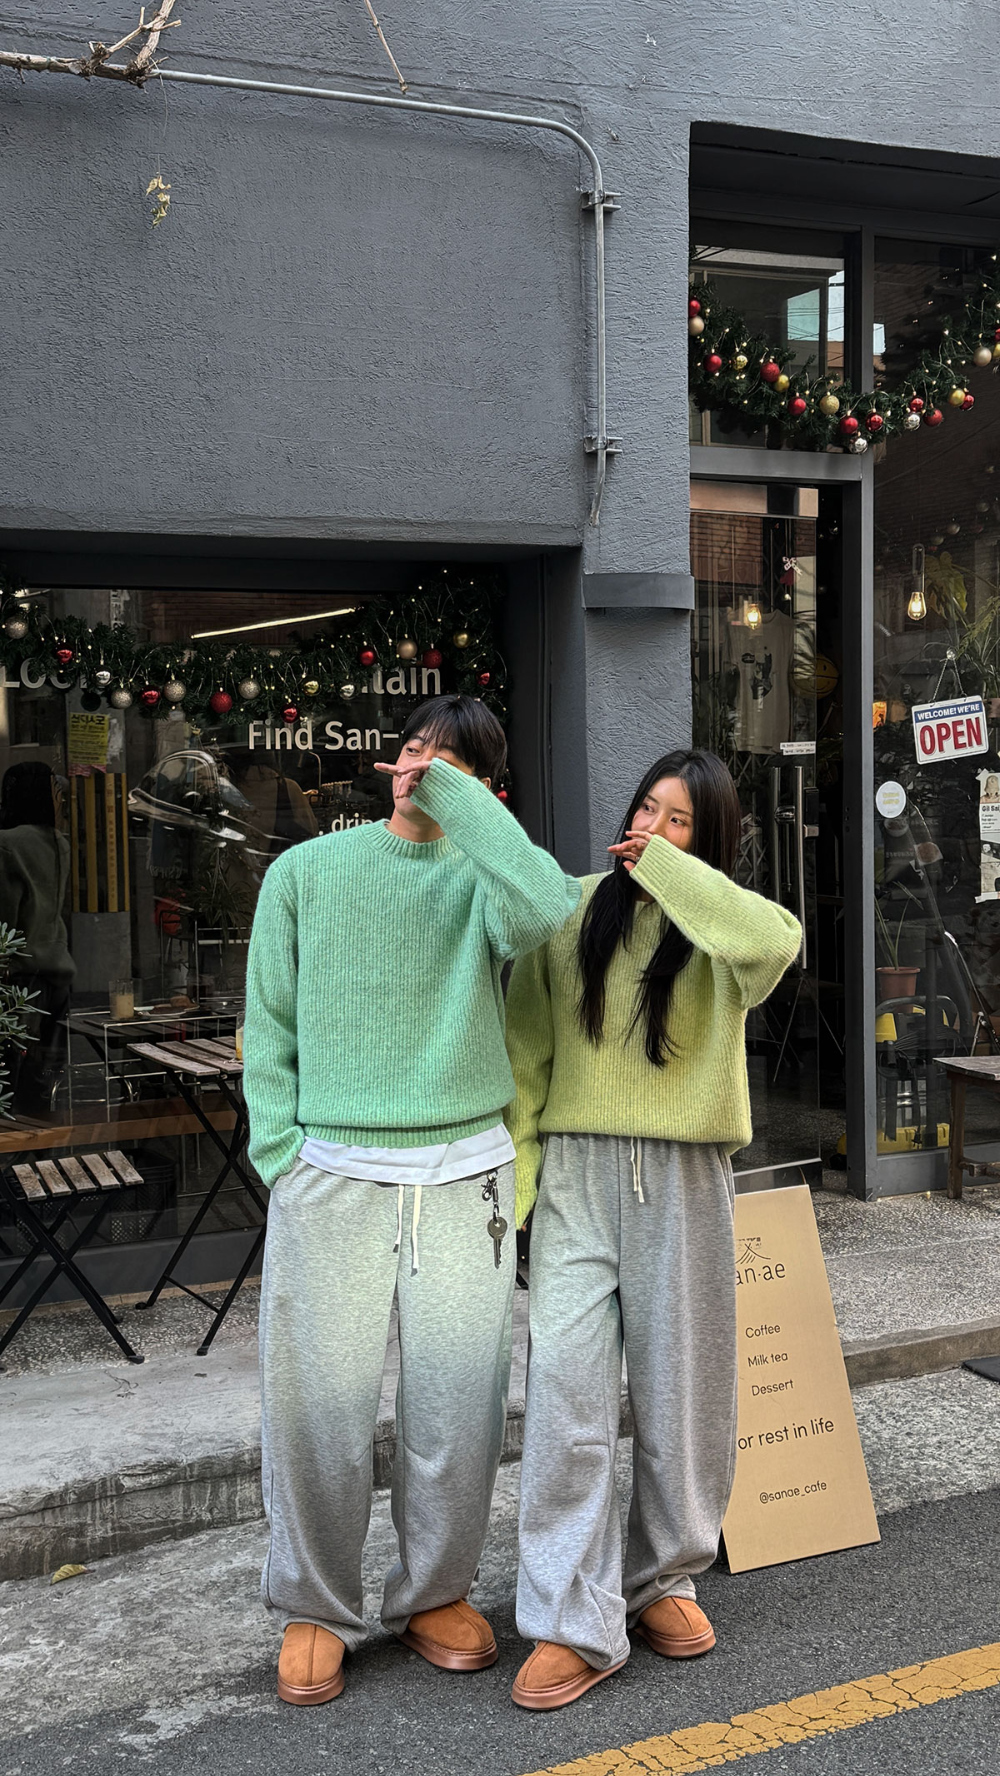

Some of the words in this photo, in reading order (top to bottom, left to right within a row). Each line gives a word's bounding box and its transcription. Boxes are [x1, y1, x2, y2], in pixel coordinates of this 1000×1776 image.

[917, 707, 957, 720] WELCOME!
[957, 703, 981, 714] WE'RE
[249, 719, 314, 750] Find
[325, 721, 404, 751] San-
[919, 717, 982, 755] OPEN
[745, 1324, 781, 1339] Coffee
[747, 1354, 769, 1368] Milk
[770, 1352, 789, 1363] tea
[751, 1379, 794, 1397] Dessert
[758, 1426, 789, 1446] rest
[792, 1422, 808, 1439] in
[810, 1417, 835, 1436] life
[759, 1480, 828, 1505] @sanae_cafe
